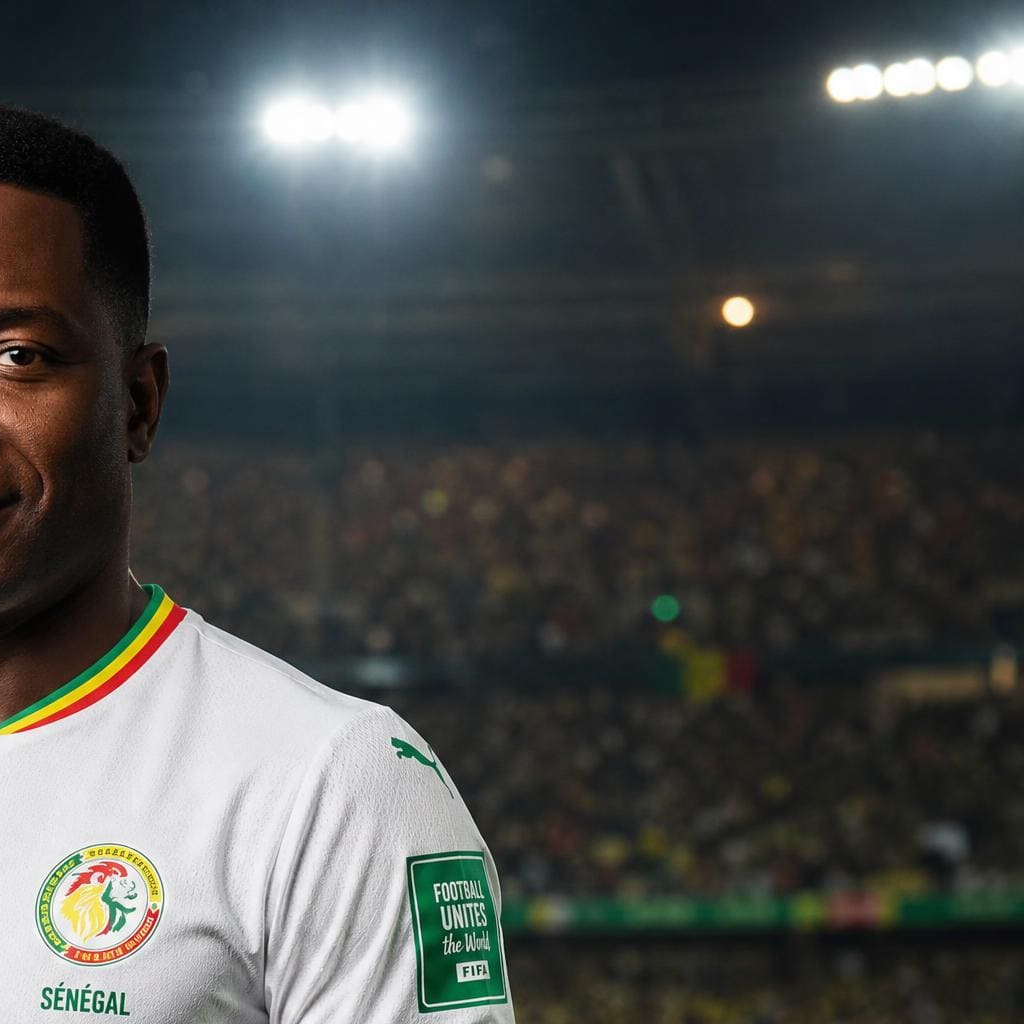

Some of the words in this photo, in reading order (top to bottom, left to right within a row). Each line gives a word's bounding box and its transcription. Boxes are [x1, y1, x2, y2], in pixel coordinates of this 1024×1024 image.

[433, 880, 485, 903] FOOTBALL
[440, 902, 487, 930] UNITES
[442, 933, 464, 955] the
[462, 964, 488, 978] FIFA
[40, 981, 130, 1016] SÉNÉGAL
